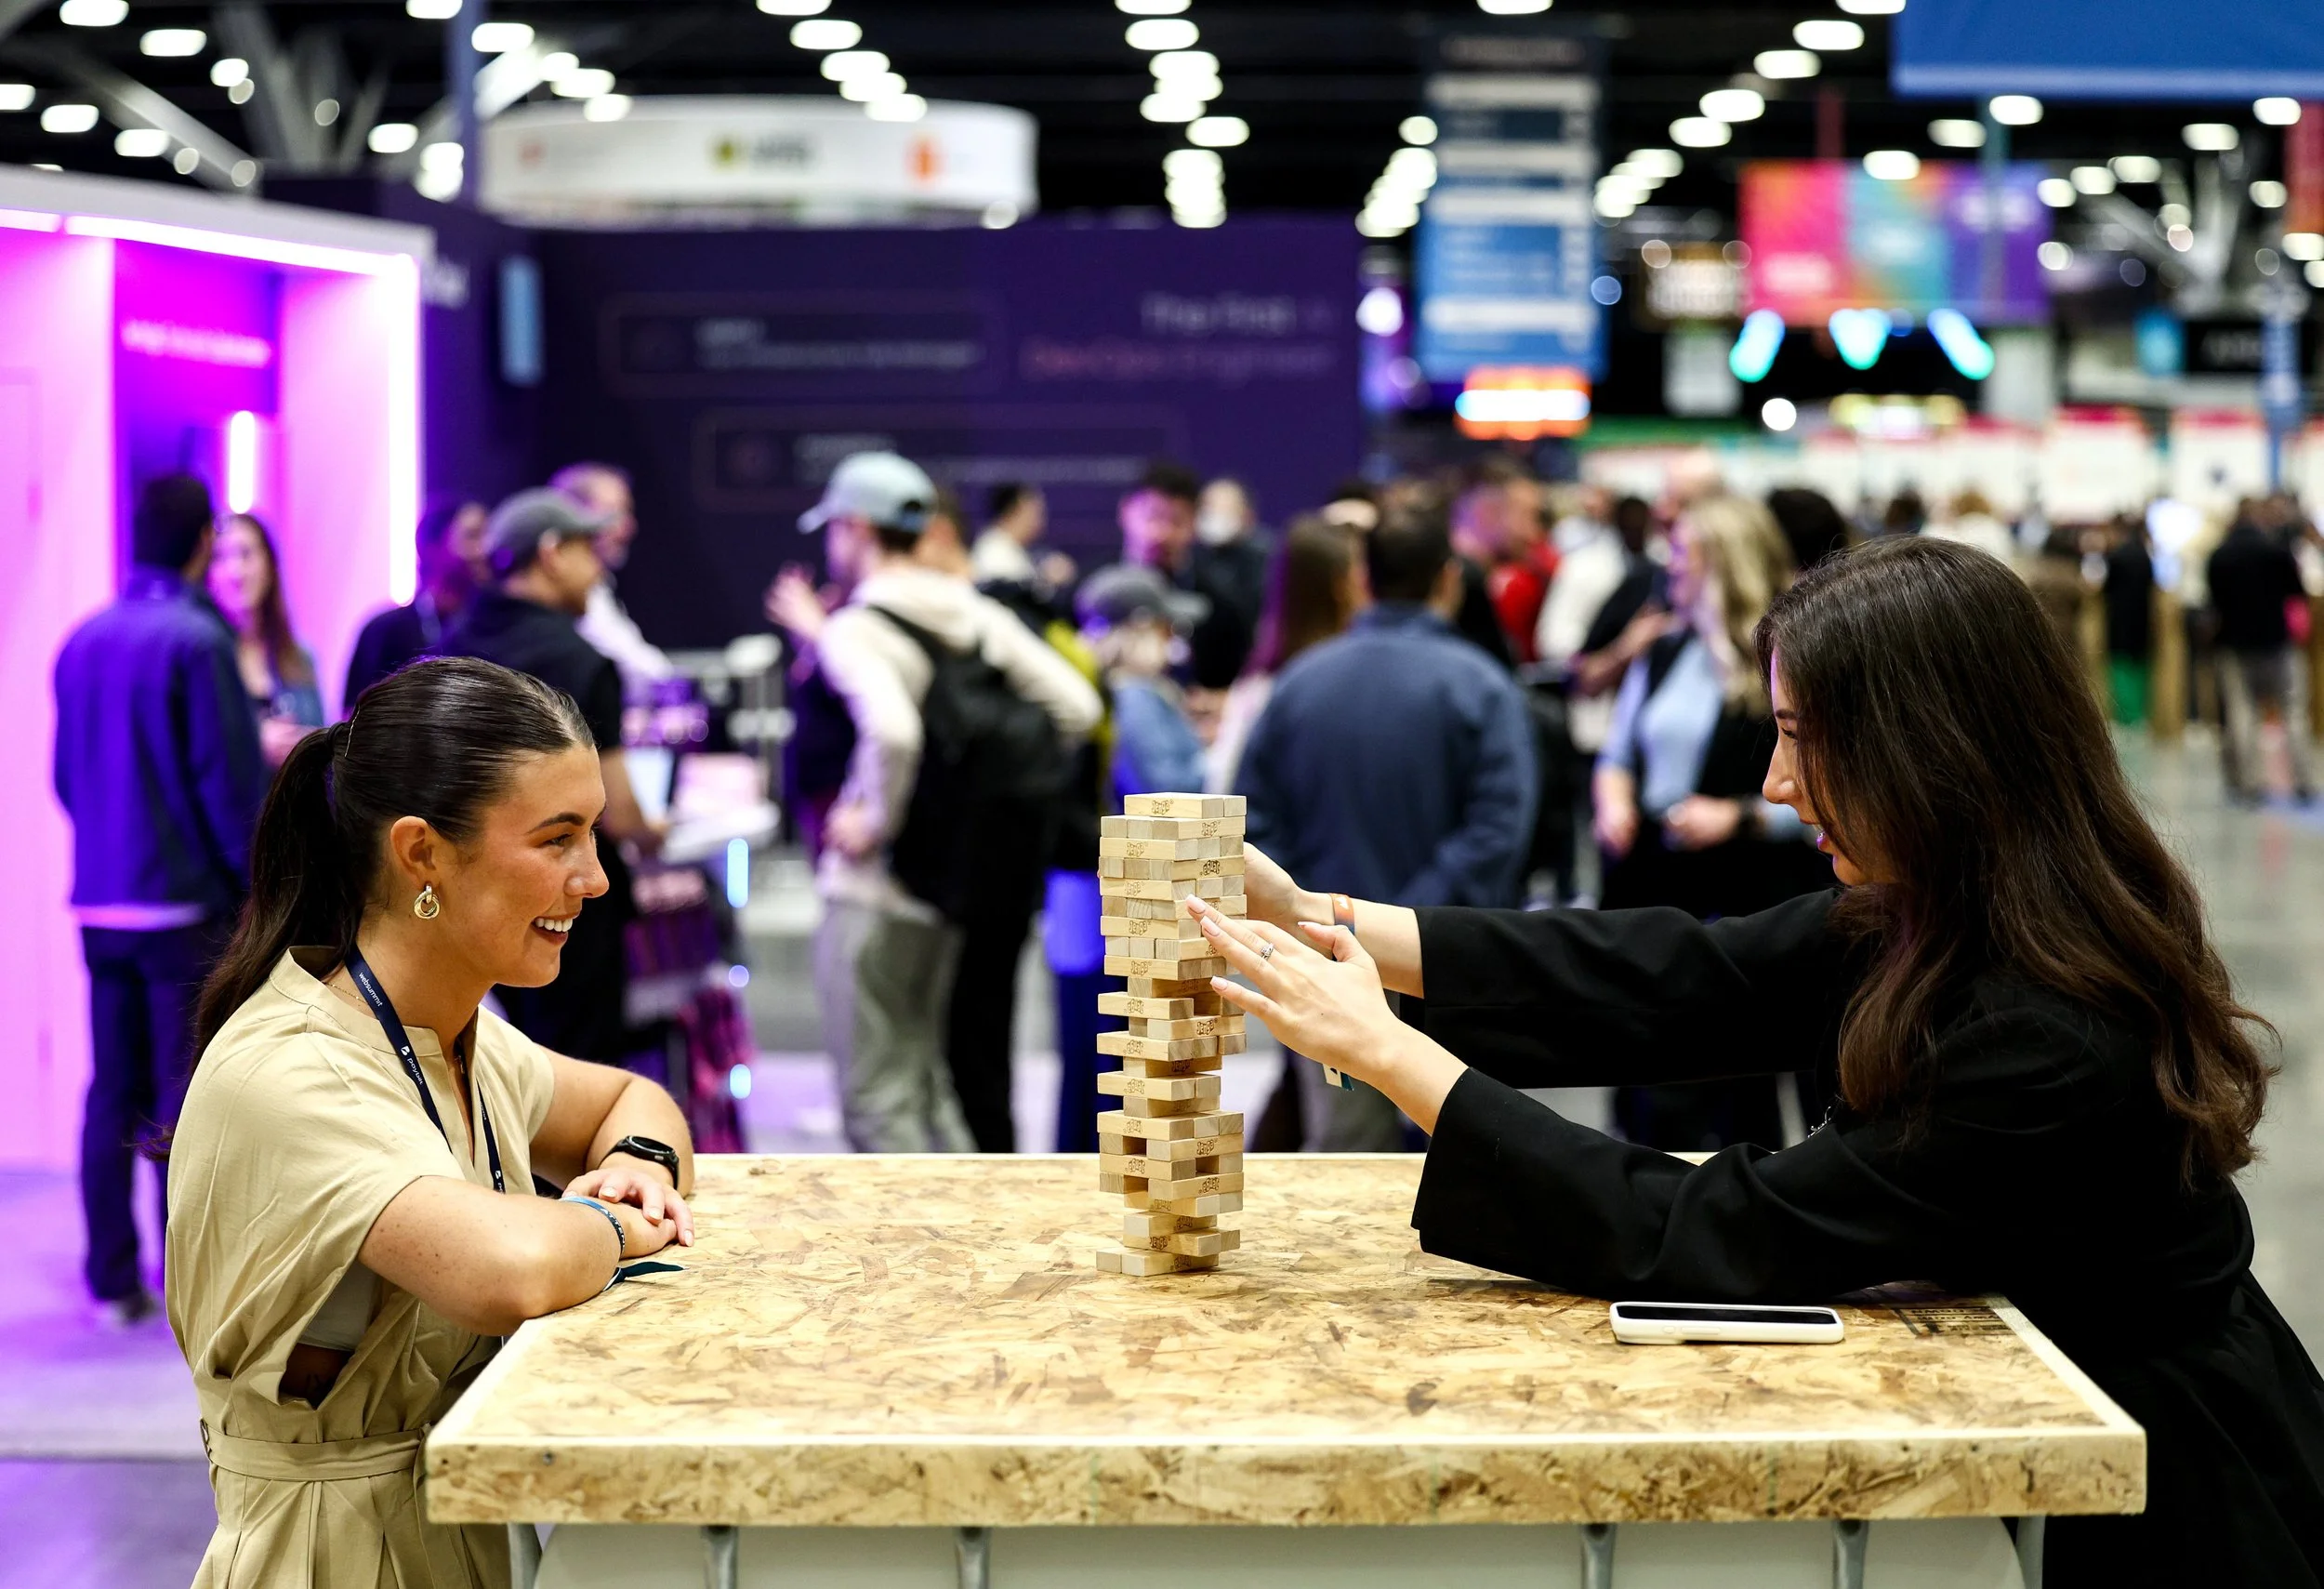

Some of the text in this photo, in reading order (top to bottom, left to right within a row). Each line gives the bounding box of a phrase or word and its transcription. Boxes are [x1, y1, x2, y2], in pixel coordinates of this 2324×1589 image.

[1152, 801, 1169, 815] Jenga
[1129, 920, 1147, 935] Jenga
[1130, 960, 1148, 975] Jenga
[359, 972, 383, 1007] websummit
[1196, 1020, 1214, 1035] Jenga
[1196, 1139, 1214, 1155] Jenga
